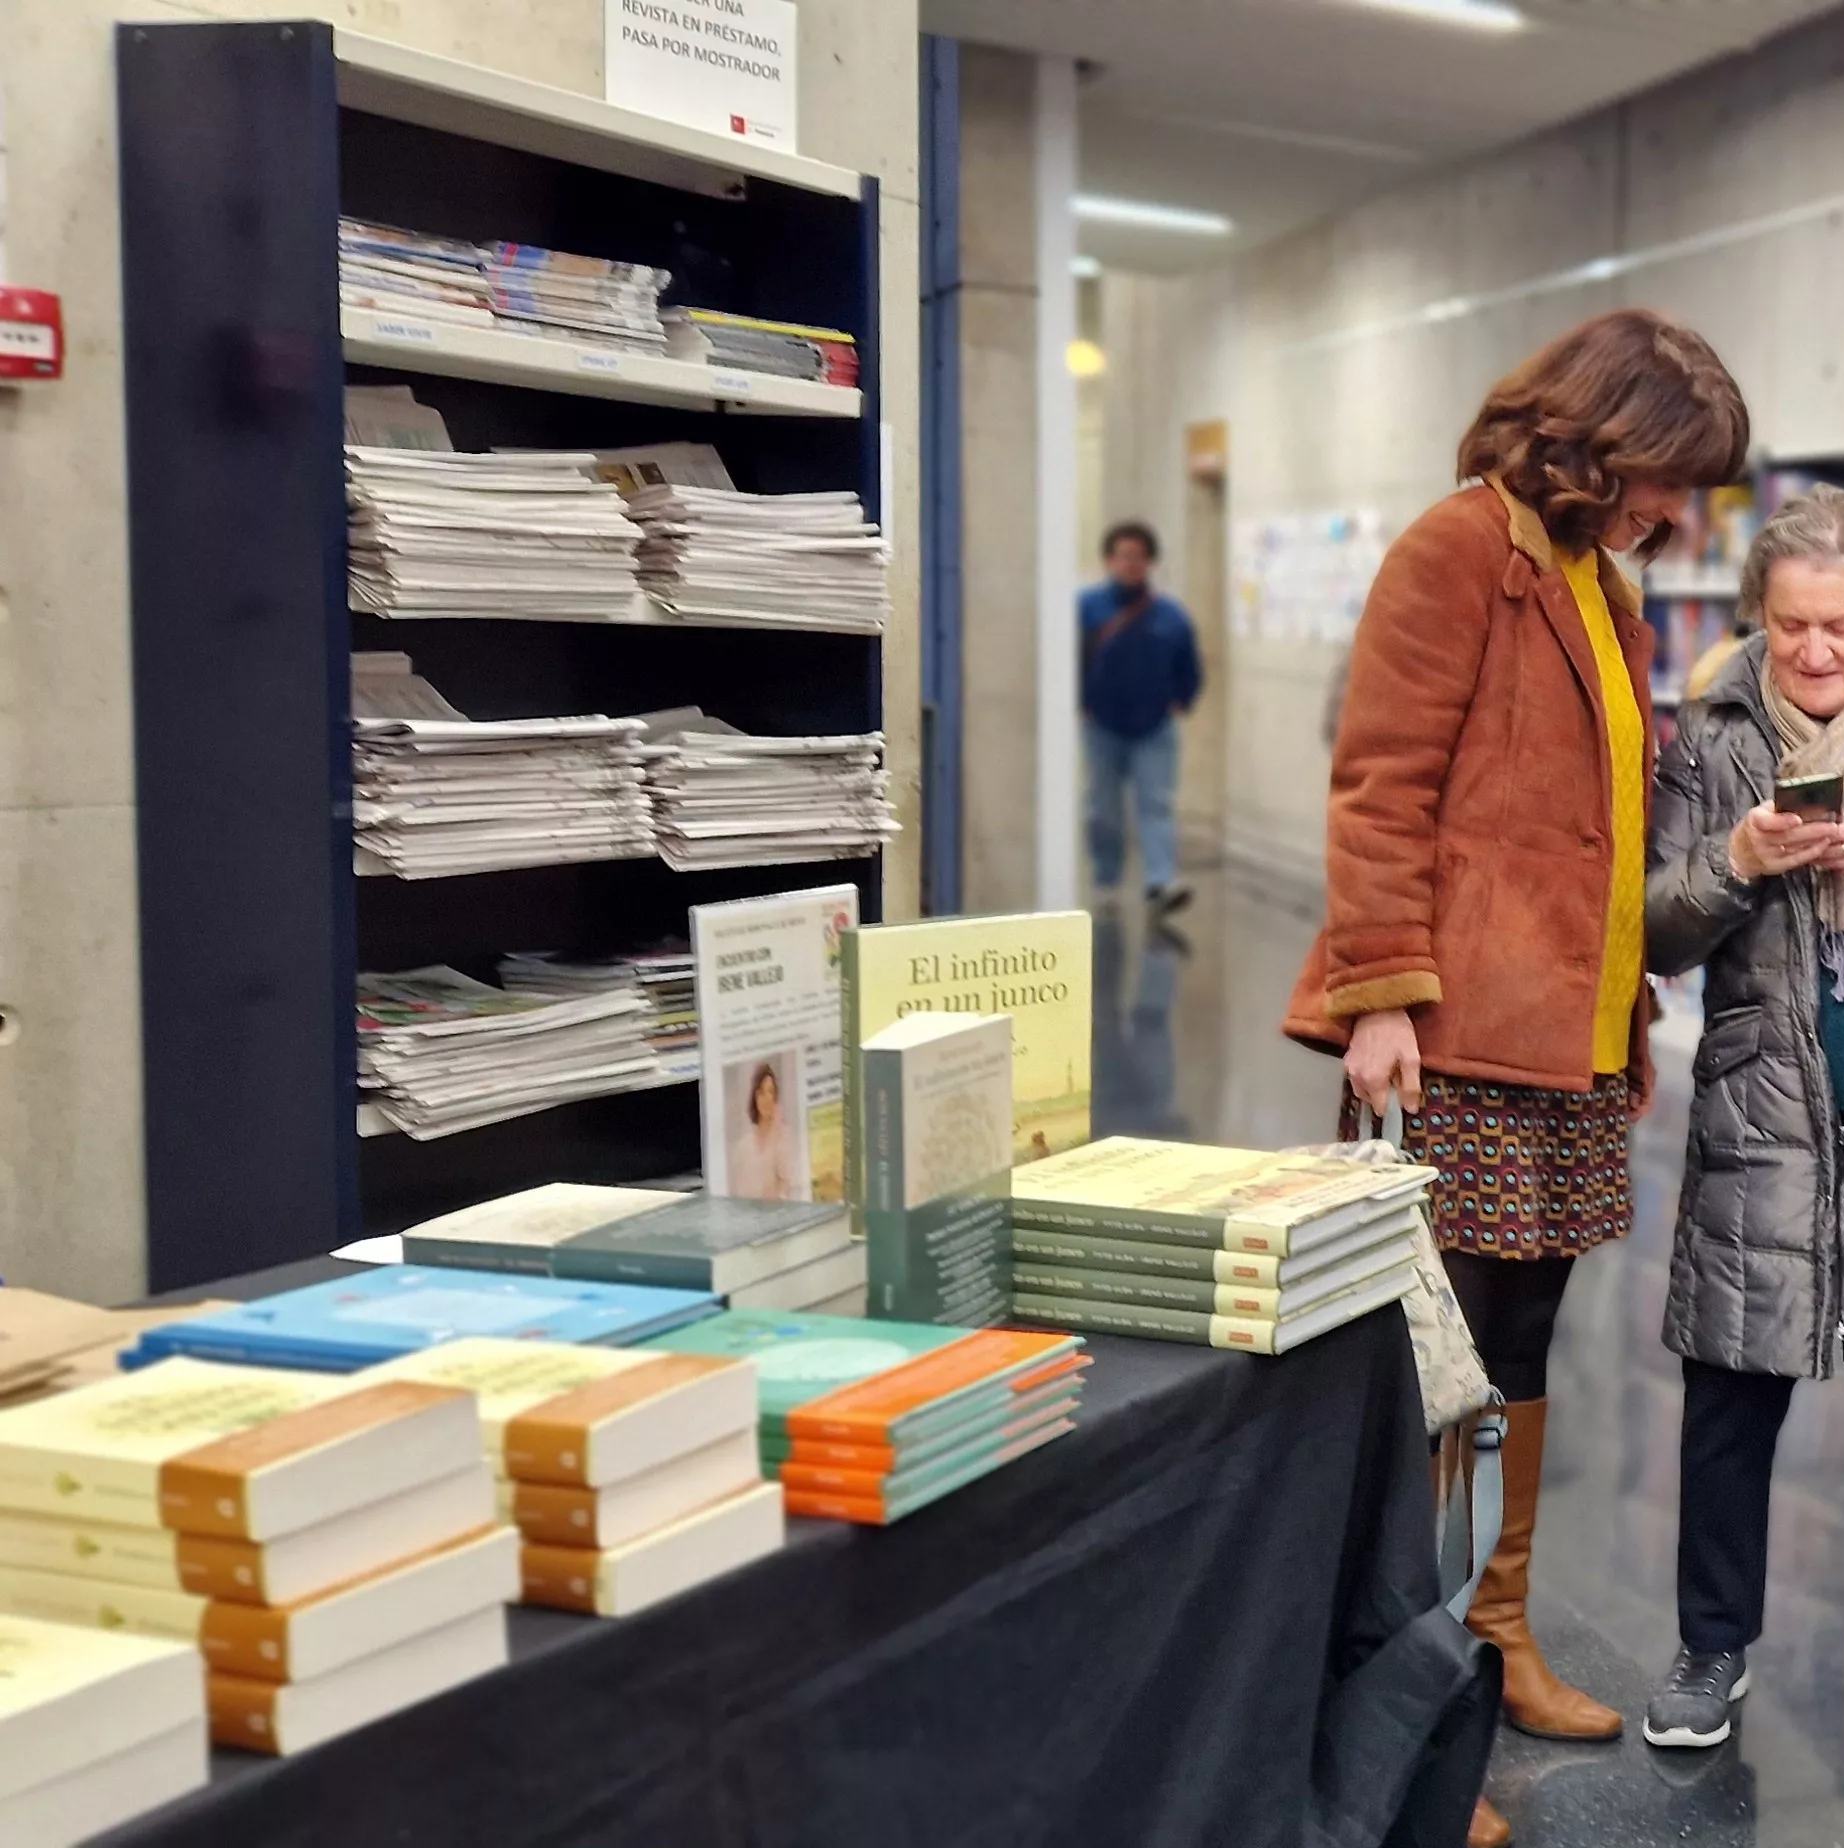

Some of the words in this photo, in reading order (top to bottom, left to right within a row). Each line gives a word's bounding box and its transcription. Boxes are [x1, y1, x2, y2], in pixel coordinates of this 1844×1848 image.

[622, 0, 680, 27] REVISTA
[682, 14, 701, 33] EN
[714, 0, 745, 17] UNA
[622, 26, 659, 50] PASA
[662, 36, 691, 58] POR
[694, 47, 781, 82] MOSTRADOR
[908, 954, 941, 986] El
[951, 946, 1058, 981] infinito
[896, 996, 933, 1019] en
[943, 992, 982, 1013] un
[991, 981, 1068, 1013] junco
